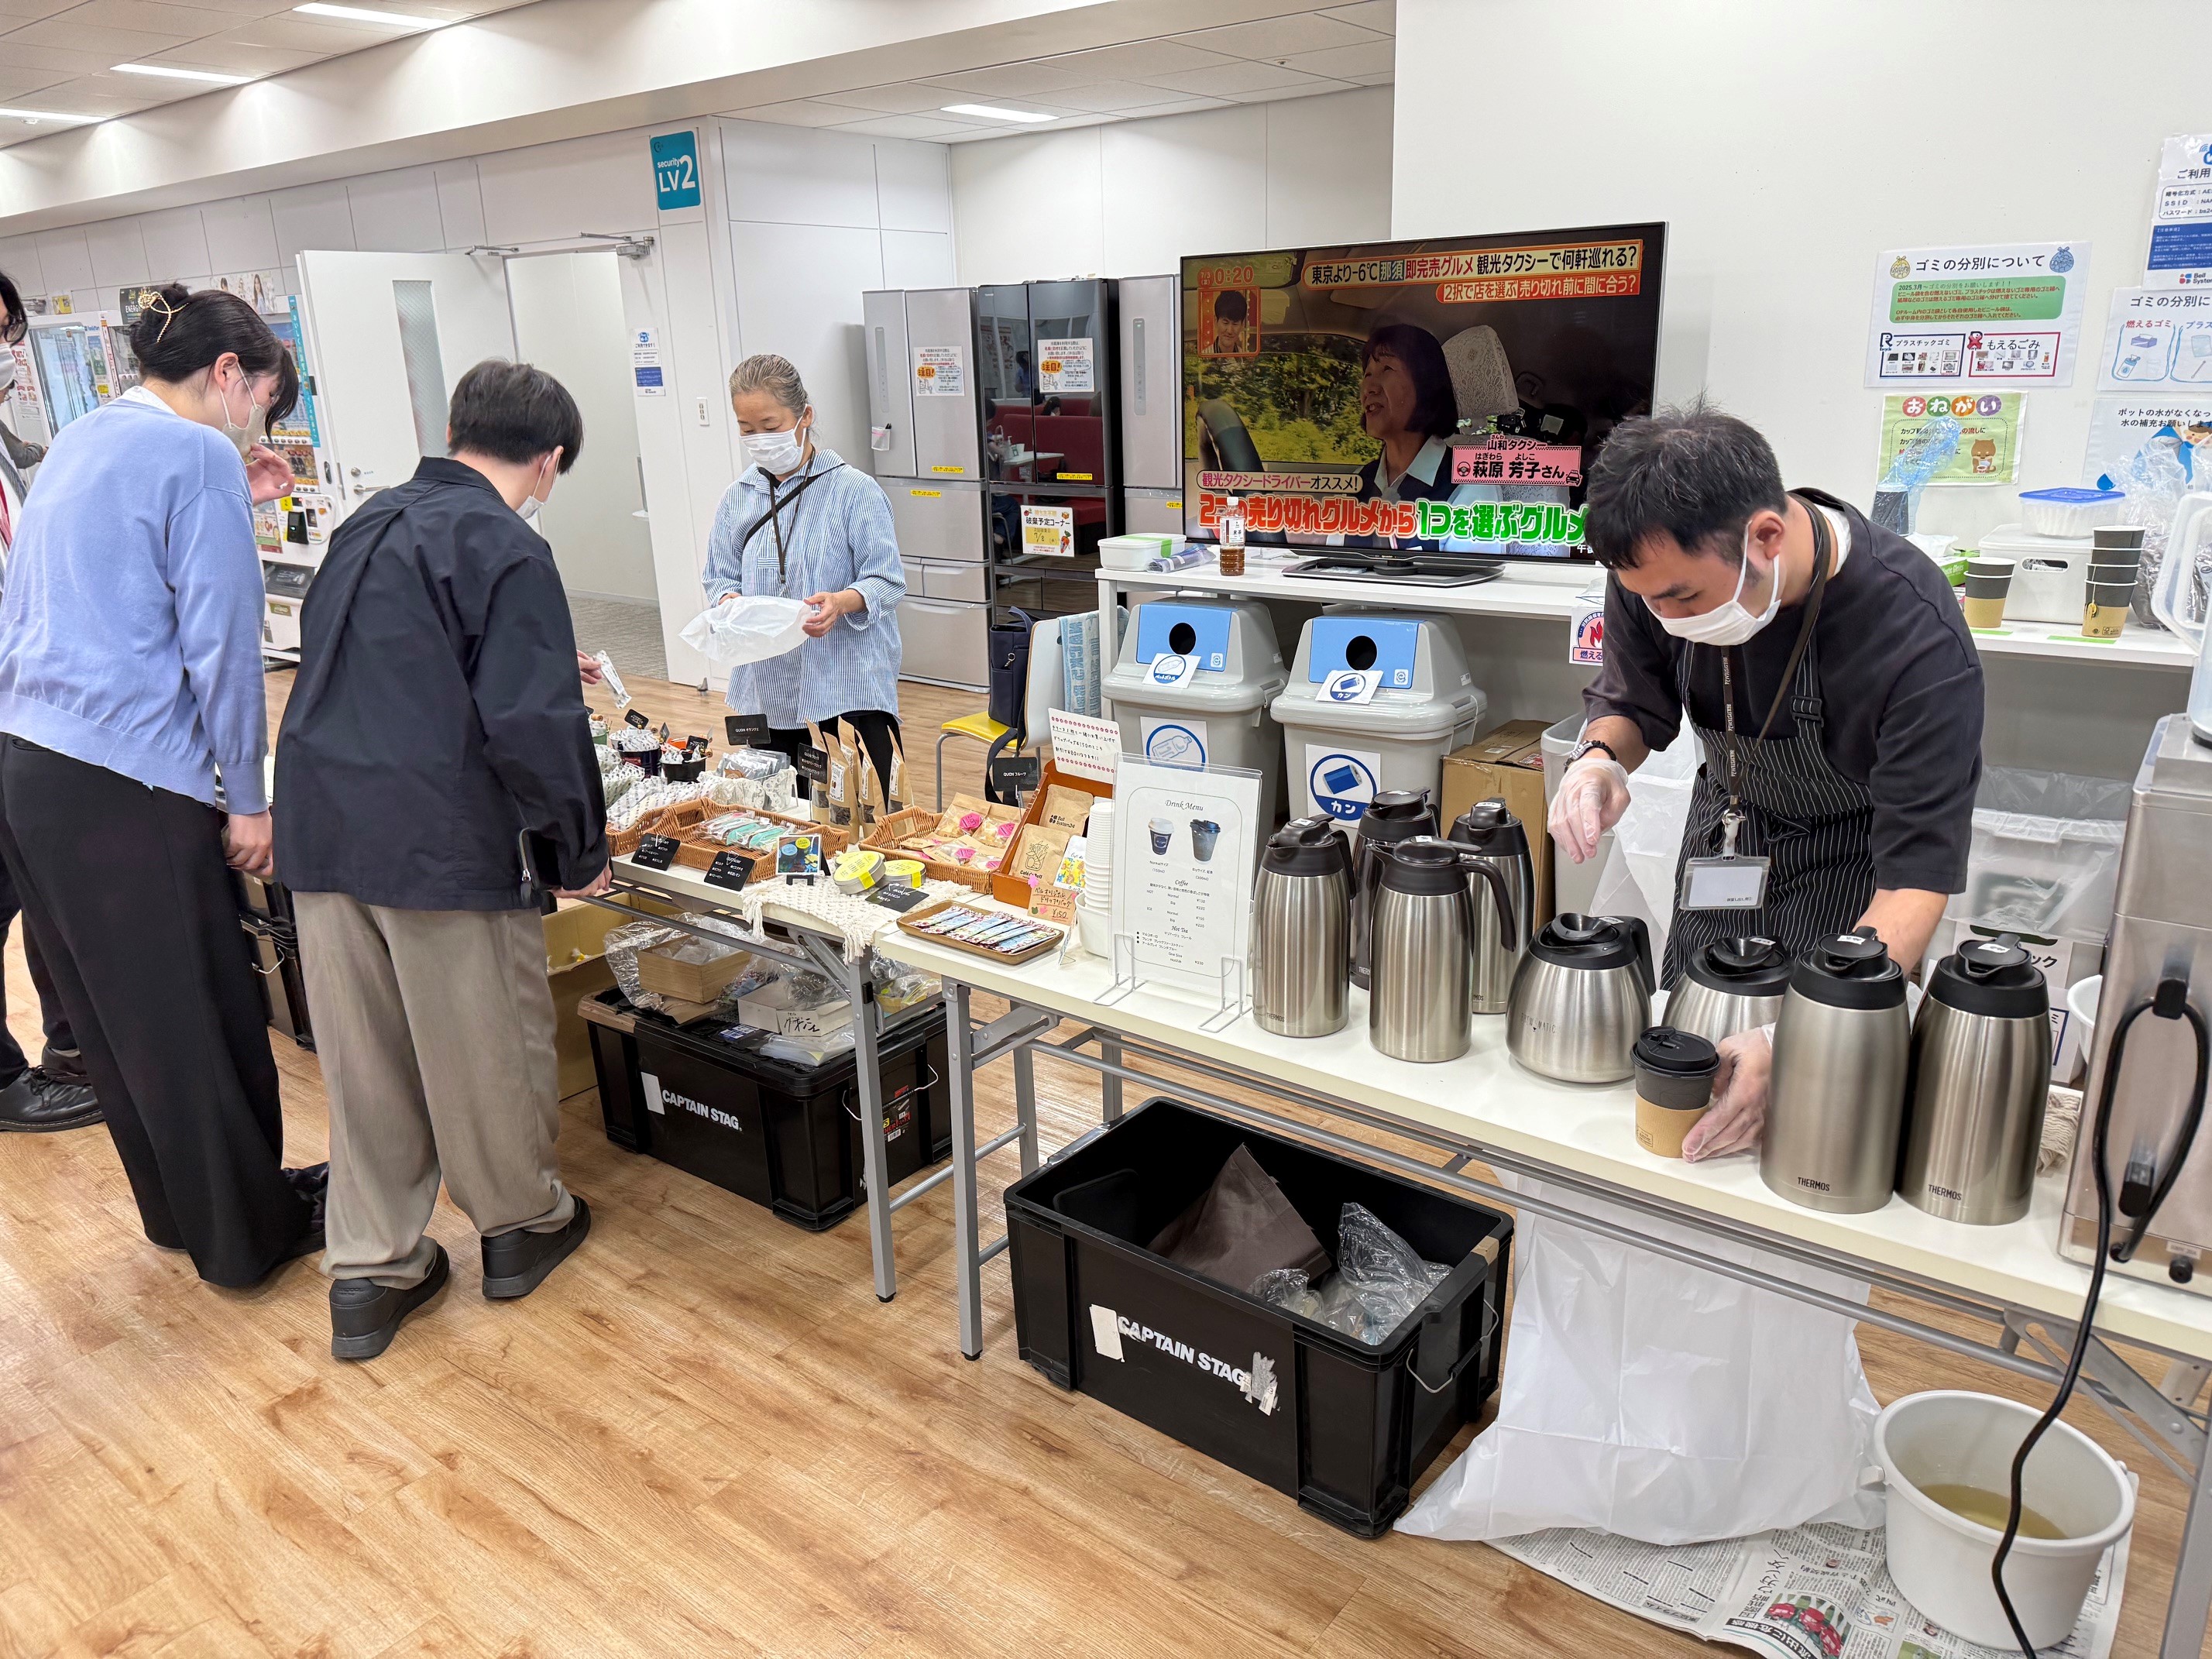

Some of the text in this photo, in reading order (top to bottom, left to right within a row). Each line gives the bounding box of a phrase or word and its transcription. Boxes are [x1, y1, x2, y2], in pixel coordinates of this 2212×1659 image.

[658, 157, 680, 168] security
[1915, 255, 2045, 272] ゴミの分別について
[2126, 320, 2171, 328] 燃えるゴミ
[1896, 338, 1950, 347] プラスチックゴミ
[1987, 338, 2041, 350] もえるごみ
[1906, 398, 1997, 414] おねがい
[1487, 439, 1547, 451] 山和タクシー
[1472, 461, 1504, 479] 萩原
[1165, 799, 1204, 812] Drink Menu
[1331, 800, 1355, 814] カン
[1266, 1012, 1285, 1022] THERMOS
[661, 1089, 740, 1131] CAPTAIN STAG
[1797, 1176, 1830, 1192] THERMOS
[1928, 1183, 1963, 1200] THERMOS
[1118, 1316, 1245, 1388] CAPTAIN STAG
